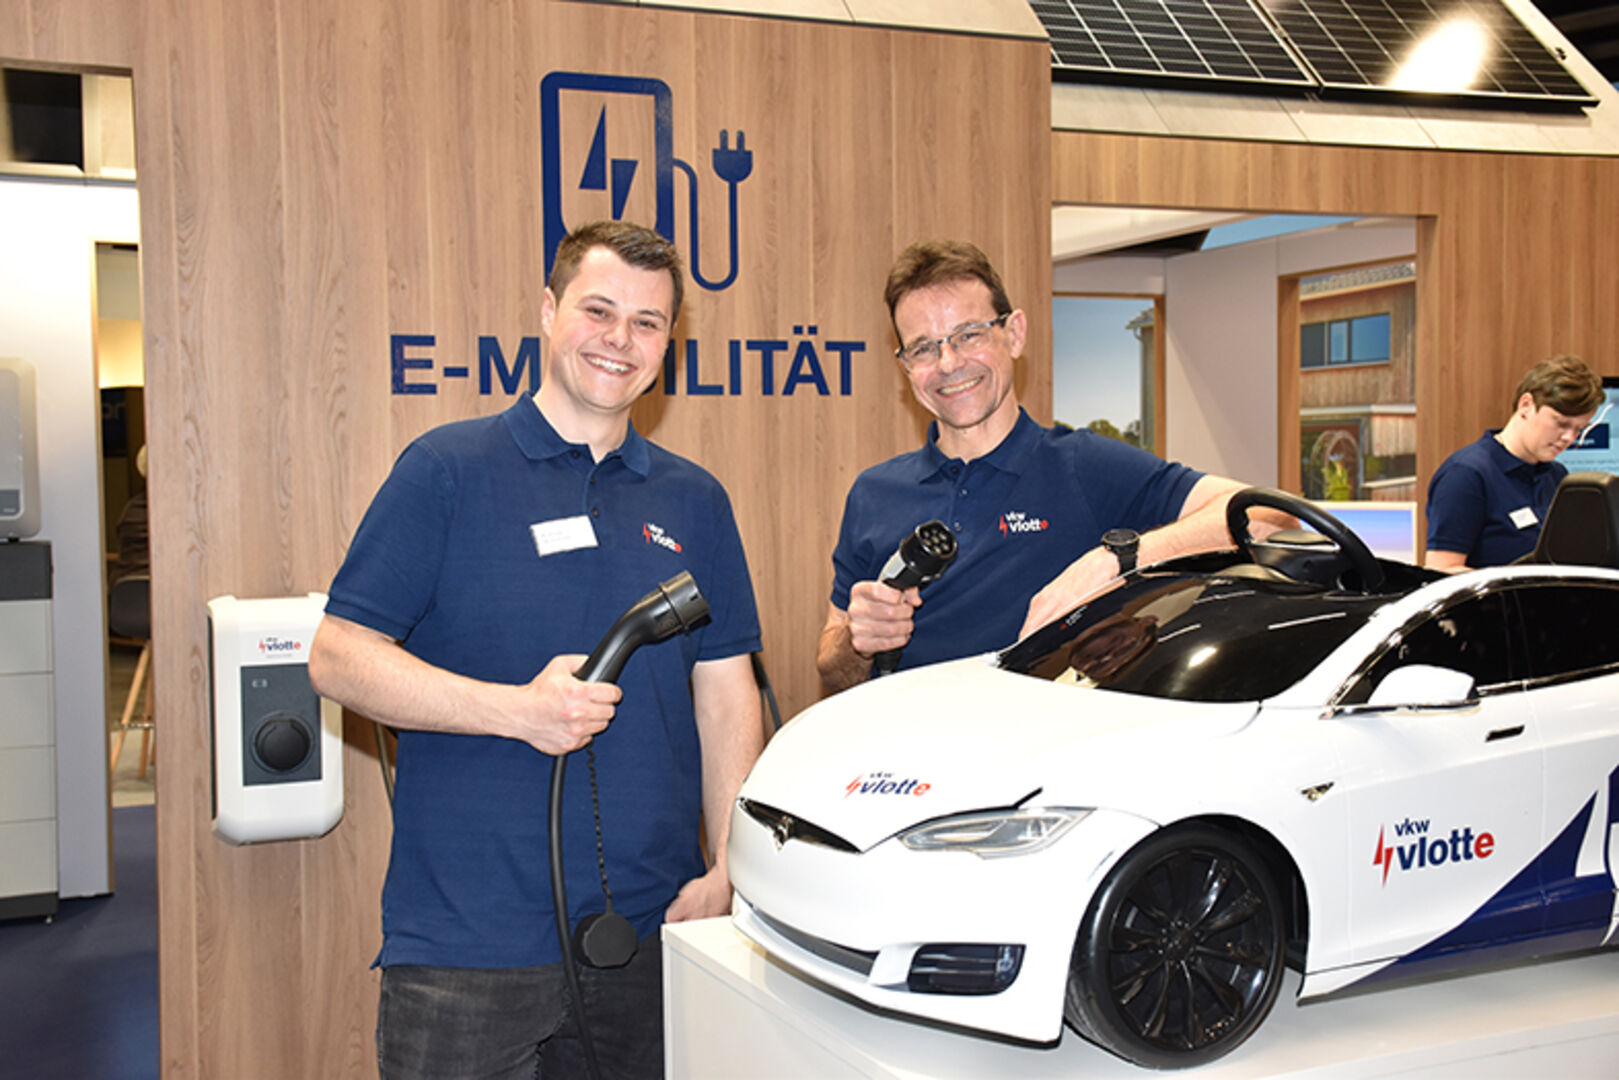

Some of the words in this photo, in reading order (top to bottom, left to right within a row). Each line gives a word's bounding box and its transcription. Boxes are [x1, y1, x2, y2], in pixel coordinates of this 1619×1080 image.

[389, 325, 866, 397] E-MILITÄT
[860, 779, 931, 796] vlotte
[1394, 818, 1430, 836] vkw
[1397, 828, 1495, 870] vlotte
